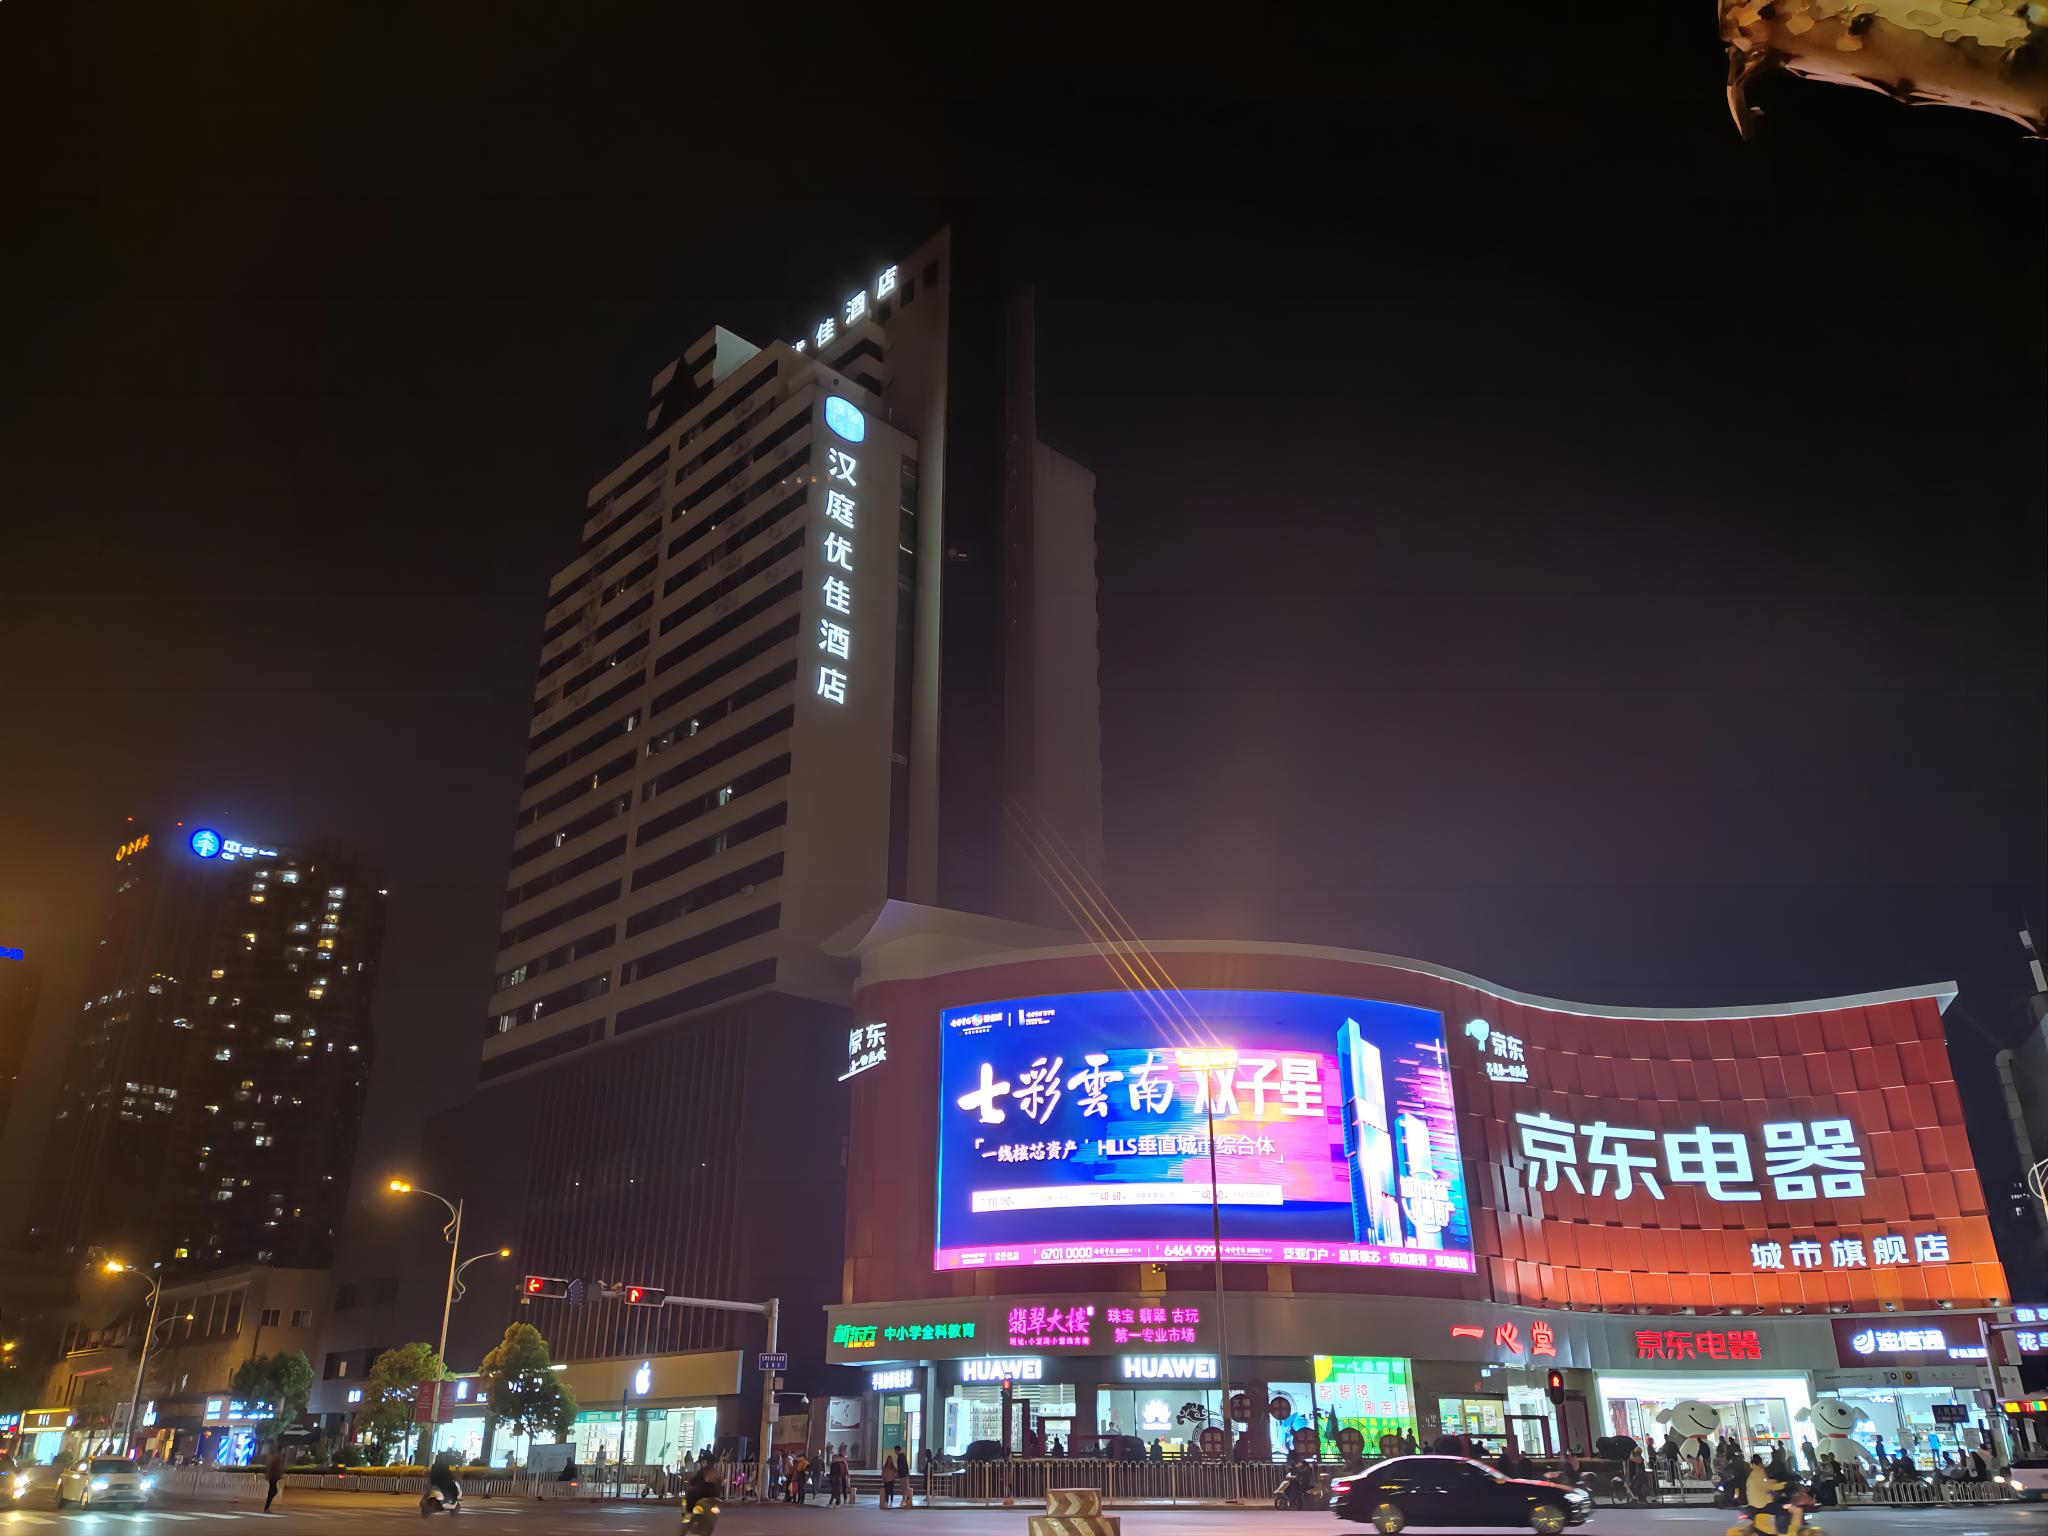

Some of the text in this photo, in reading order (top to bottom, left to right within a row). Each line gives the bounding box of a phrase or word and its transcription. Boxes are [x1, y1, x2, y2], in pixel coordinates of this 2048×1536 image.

[817, 447, 857, 705] 汉庭优佳酒店
[849, 1023, 887, 1055] 京东
[1490, 1031, 1525, 1062] 京东
[1515, 1112, 1866, 1202] 京东电器
[1194, 1244, 1224, 1257] 999
[1751, 1233, 1951, 1272] 城市旗舰店
[1008, 1306, 1091, 1335] 翡翠大楼
[1107, 1308, 1135, 1324] 珠宝
[1139, 1308, 1168, 1324] 翡翠
[1171, 1308, 1200, 1324] 古玩
[833, 1324, 878, 1348] 新东方
[883, 1322, 976, 1341] 中小学全科教育
[1114, 1327, 1196, 1344] 第一专业市场
[1450, 1321, 1557, 1358] 一心堂
[1876, 1328, 1947, 1352] 迪信通
[1634, 1329, 1763, 1361] 京东电器
[963, 1358, 1043, 1381] HUAWEI
[1124, 1356, 1217, 1379] HUAWEI
